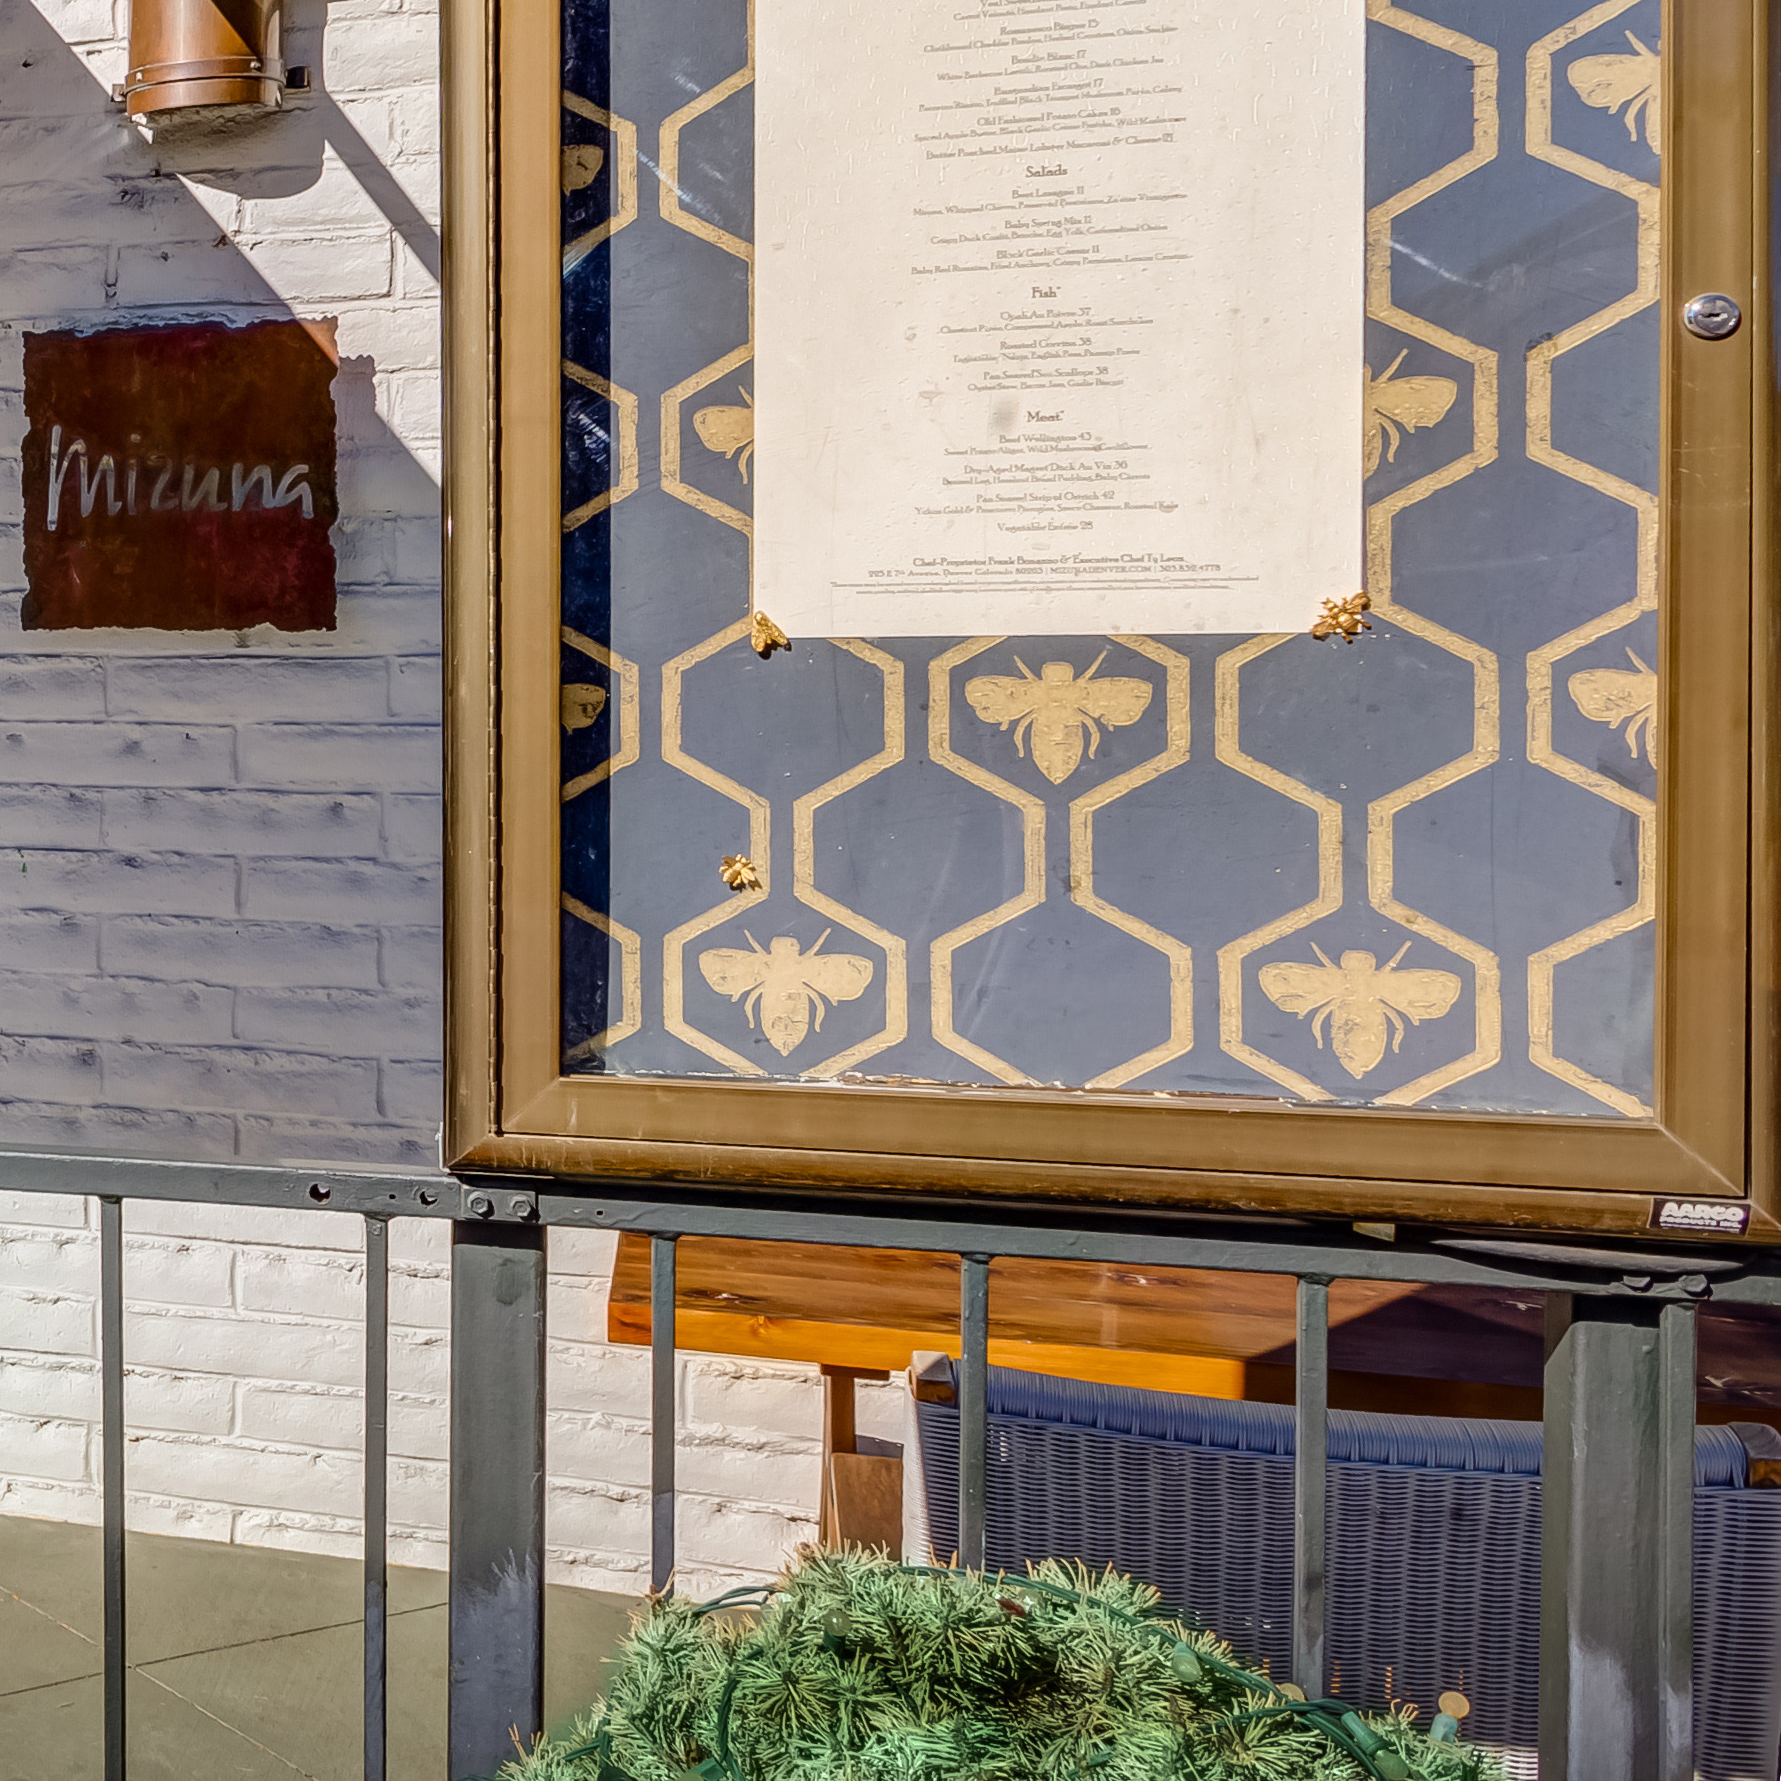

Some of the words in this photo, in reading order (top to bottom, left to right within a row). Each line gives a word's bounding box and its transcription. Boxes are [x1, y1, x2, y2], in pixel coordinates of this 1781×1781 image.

[1093, 78, 1103, 88] 17
[977, 116, 996, 126] Old
[1111, 136, 1125, 146] &
[1025, 163, 1067, 178] Salads
[1078, 307, 1091, 317] 37
[1078, 337, 1091, 346] 38
[1095, 366, 1108, 375] 38
[1022, 432, 1076, 444] Wellington
[977, 494, 993, 503] Pan
[1101, 490, 1114, 500] 42
[988, 556, 1015, 566] Frank
[1059, 555, 1071, 564] &
[1073, 554, 1119, 564] Executive
[1120, 554, 1145, 563] Chef
[1661, 1202, 1744, 1221] AARCO
